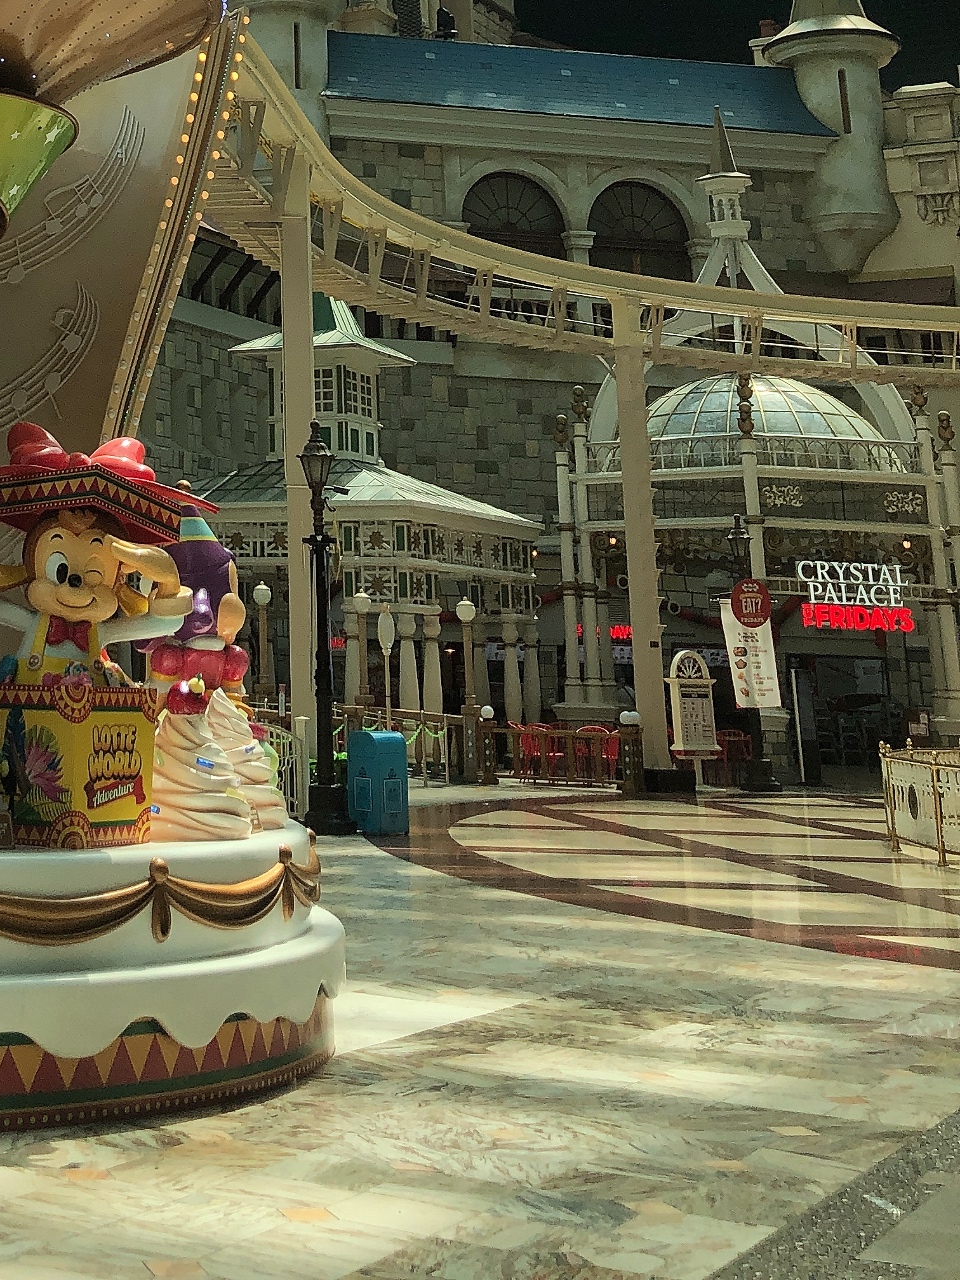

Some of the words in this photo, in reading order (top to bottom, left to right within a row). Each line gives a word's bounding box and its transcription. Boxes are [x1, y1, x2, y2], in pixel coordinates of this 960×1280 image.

[797, 560, 909, 586] CRYSTAL
[807, 581, 904, 607] PALACE
[815, 605, 915, 633] FRIDAYS
[93, 725, 137, 753] LOTTE
[88, 750, 142, 782] WORLD
[93, 783, 135, 807] Adventure
